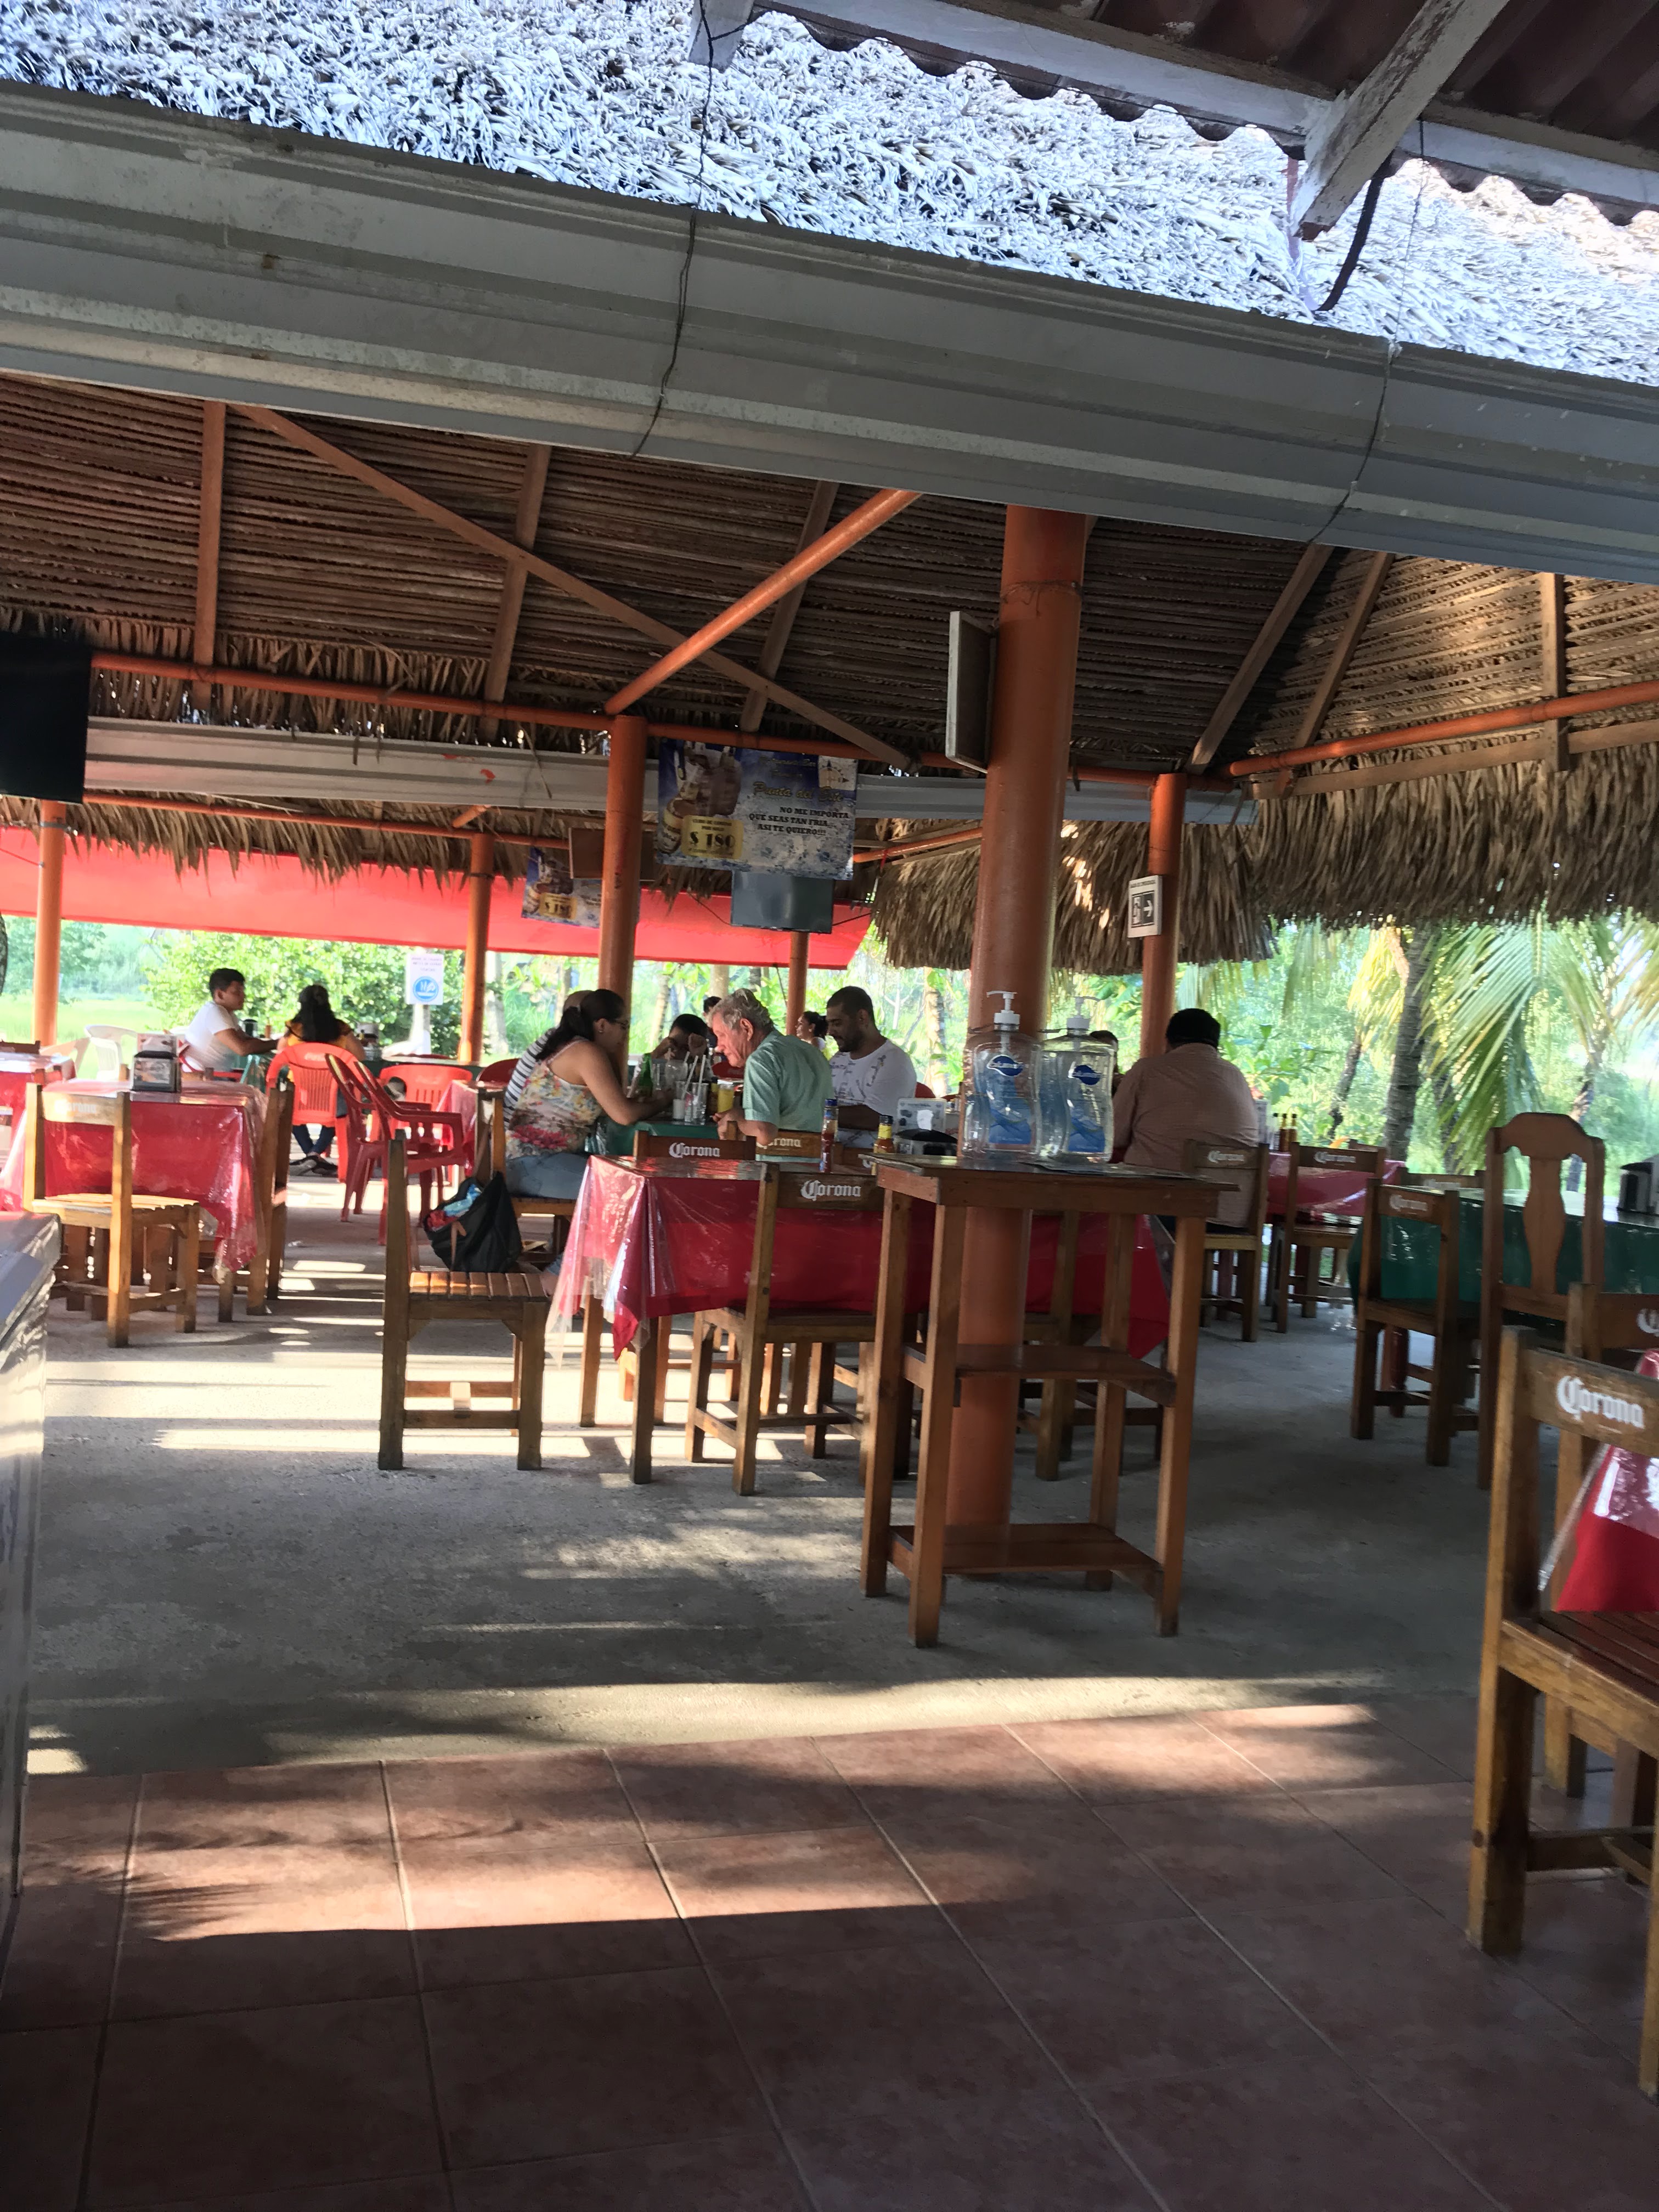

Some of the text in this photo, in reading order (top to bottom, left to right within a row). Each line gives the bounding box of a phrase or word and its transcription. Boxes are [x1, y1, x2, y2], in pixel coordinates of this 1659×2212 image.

[748, 813, 766, 821] QUE
[768, 815, 789, 823] SEAS
[809, 809, 850, 819] IMPORTA
[706, 833, 736, 848] 180
[669, 1142, 720, 1158] Corona
[800, 1180, 861, 1201] Corona
[1556, 1375, 1645, 1429] Corona
